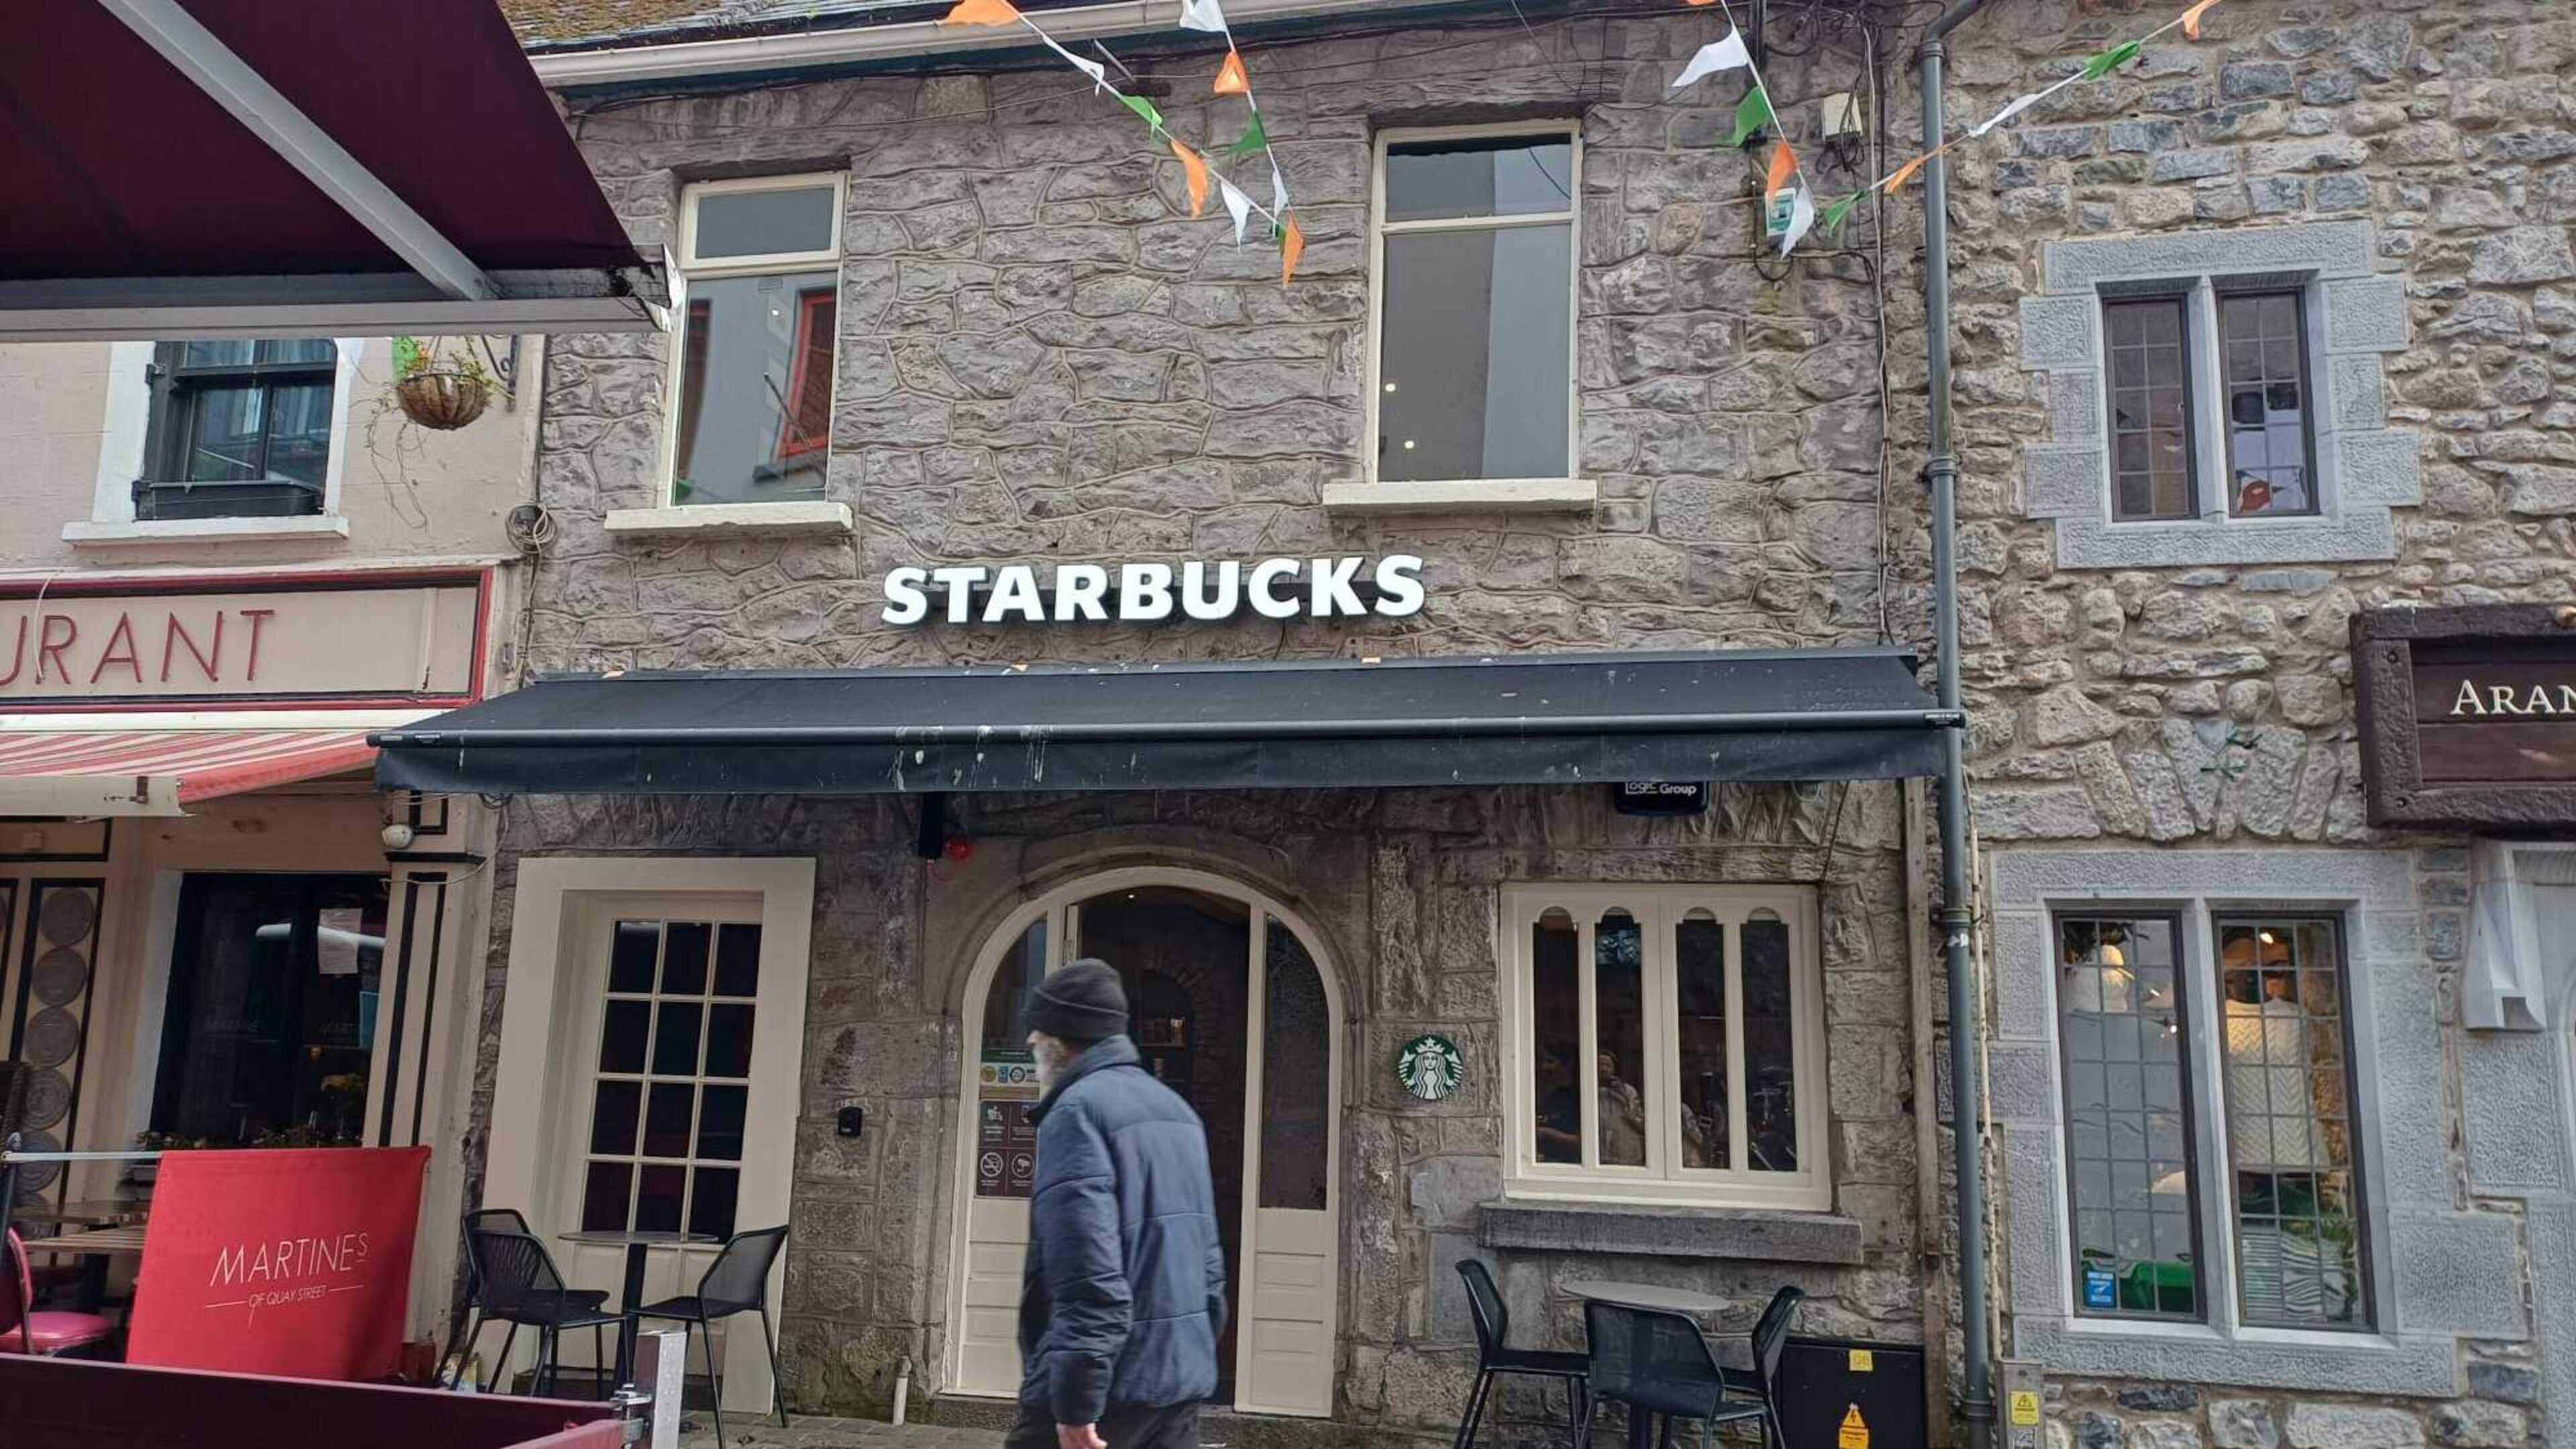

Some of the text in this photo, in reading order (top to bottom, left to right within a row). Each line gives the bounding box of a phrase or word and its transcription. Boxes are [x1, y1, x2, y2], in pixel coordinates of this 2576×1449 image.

[880, 554, 1426, 625] STARBUCKS
[1659, 784, 1697, 796] Group
[210, 1232, 369, 1287] MARTINES
[249, 1285, 327, 1307] OF QUAY STREET
